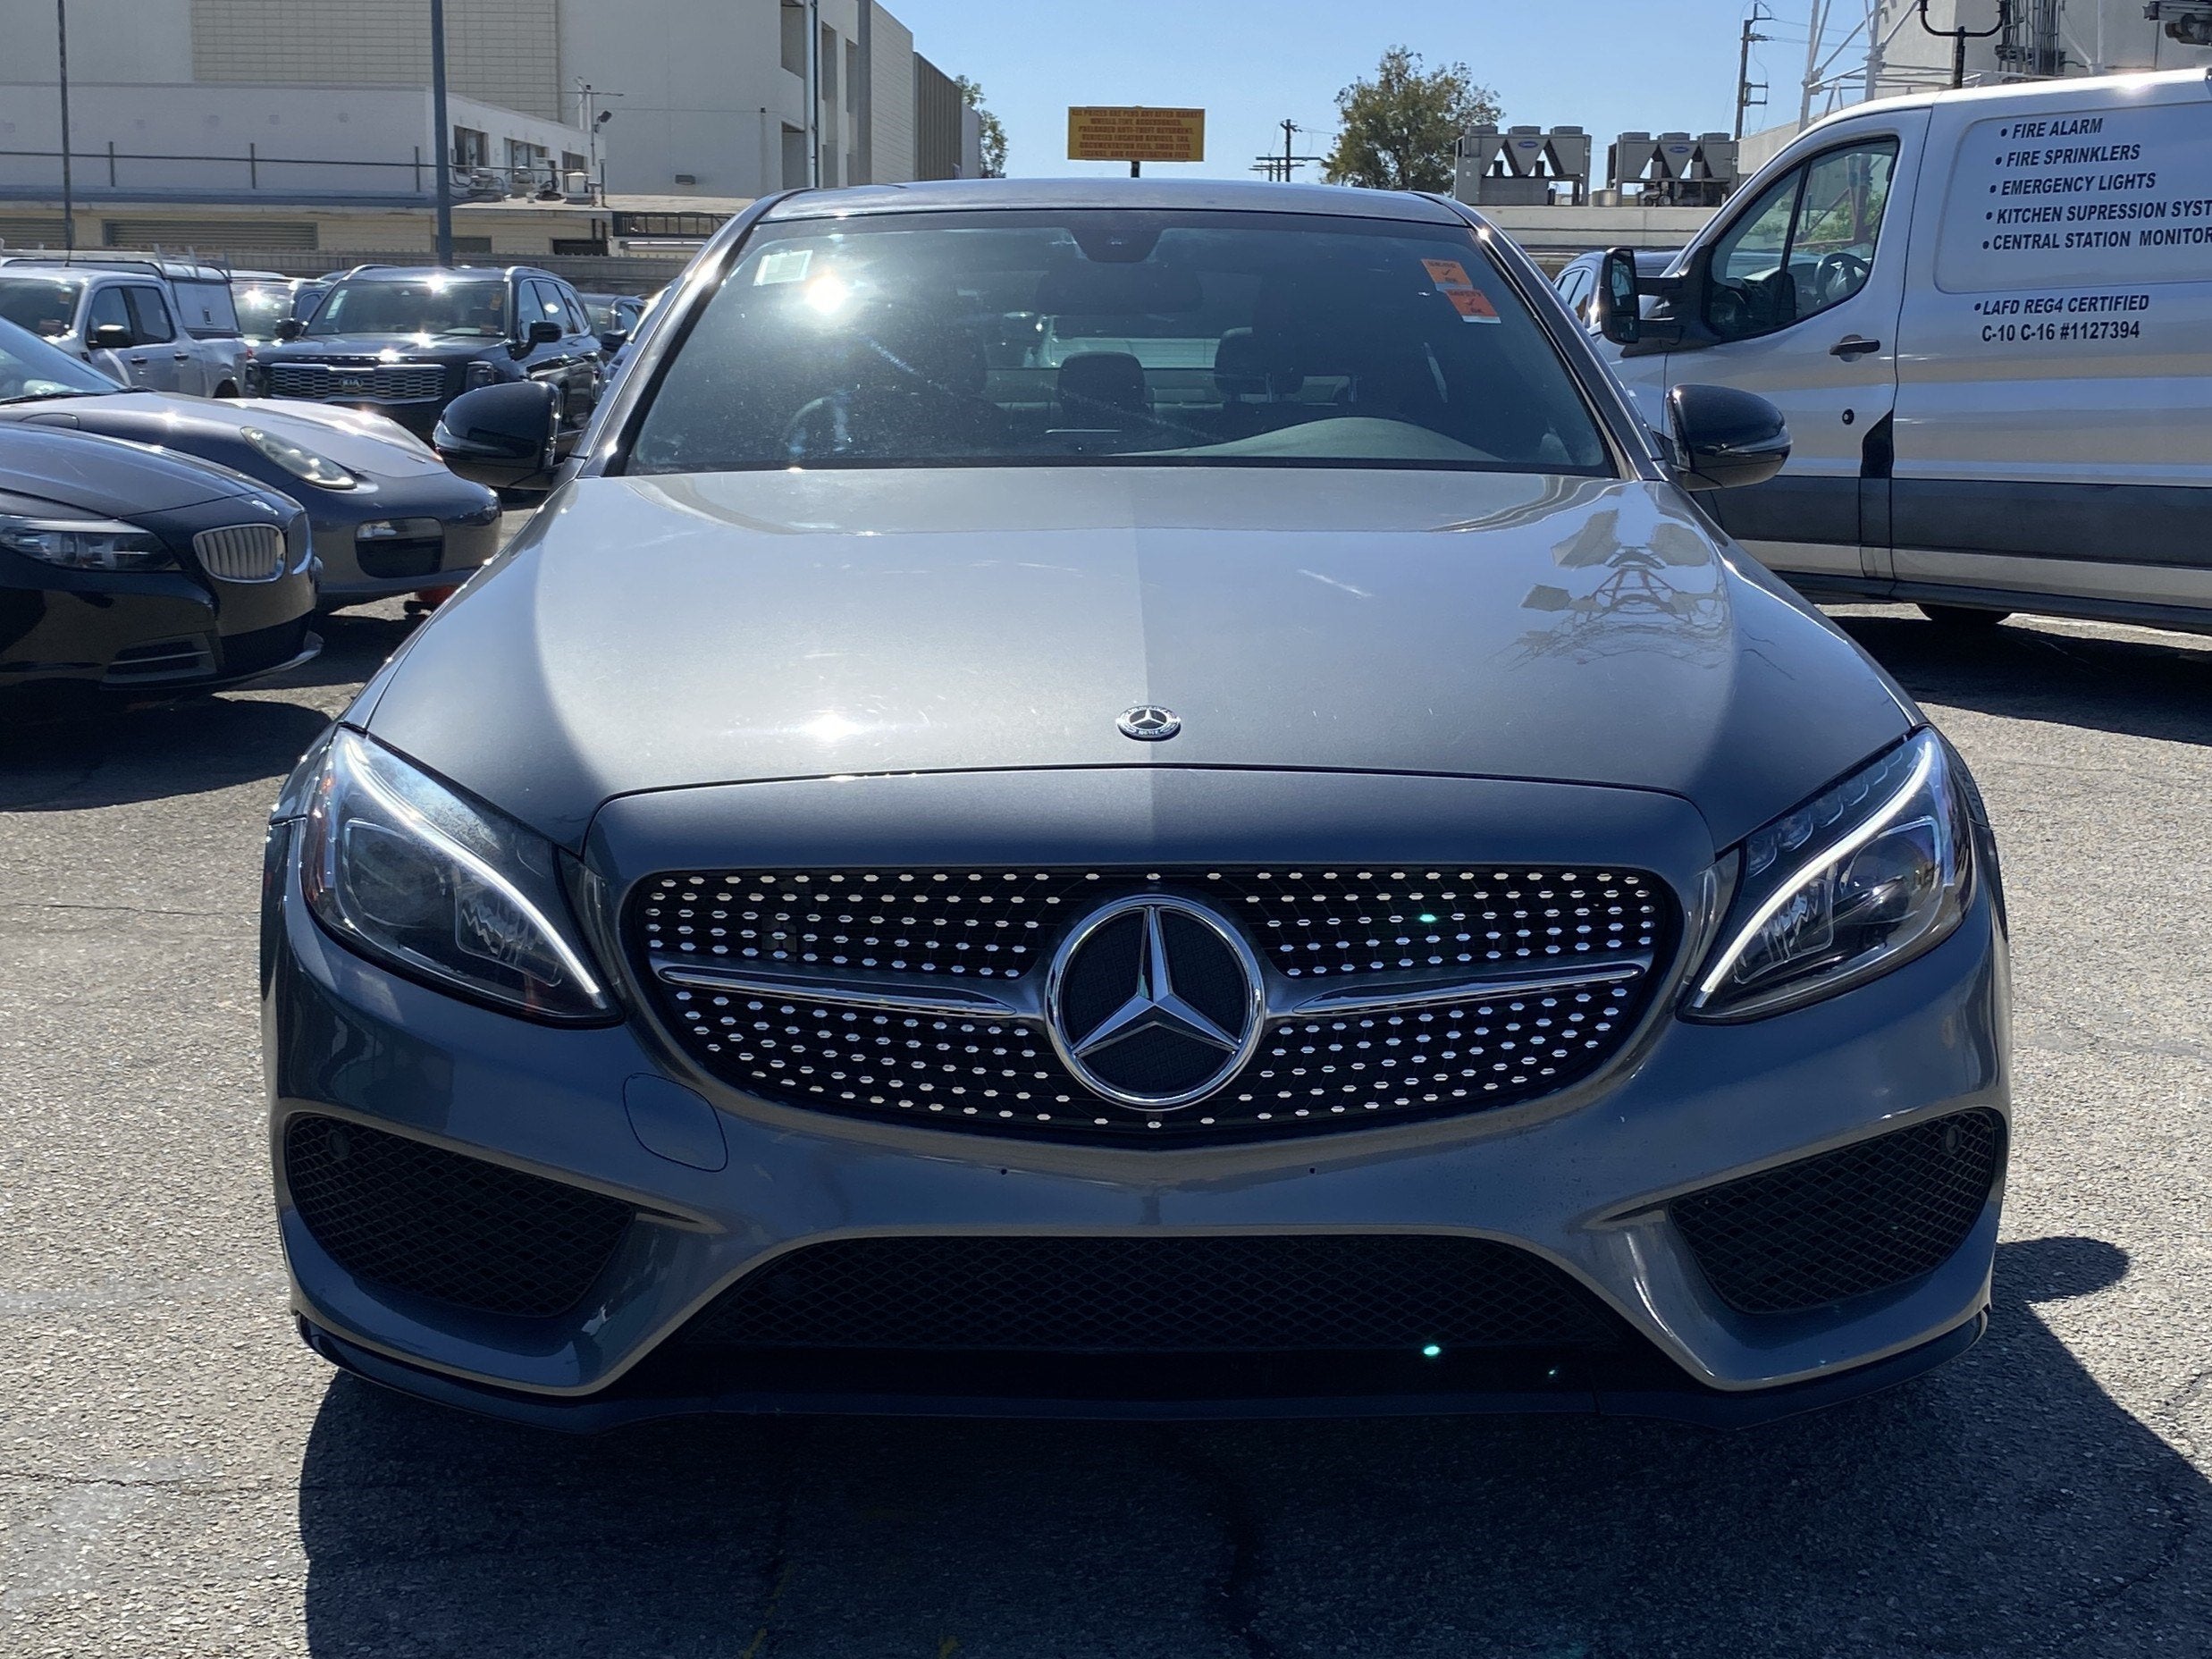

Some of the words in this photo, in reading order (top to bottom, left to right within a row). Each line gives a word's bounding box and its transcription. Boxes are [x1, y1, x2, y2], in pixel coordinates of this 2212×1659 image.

[2013, 122, 2047, 139] FIRE
[2049, 118, 2103, 136] ALARM
[2006, 150, 2040, 167] FIRE
[2043, 144, 2141, 165] SPRINKLERS
[2001, 176, 2095, 196] EMERGENCY
[2098, 172, 2156, 190] LIGHTS
[1997, 206, 2063, 224] KITCHEN
[2066, 201, 2167, 222] SUPRESSION
[1992, 232, 2060, 250] CENTRAL
[2065, 230, 2132, 248] STATION
[1982, 299, 2020, 316] LAFD
[2023, 298, 2065, 314] REG4
[2067, 294, 2149, 313] CERTIFIED
[1981, 324, 2015, 342] C-10
[2021, 323, 2056, 341] C-16
[2060, 320, 2140, 341] #1127394
